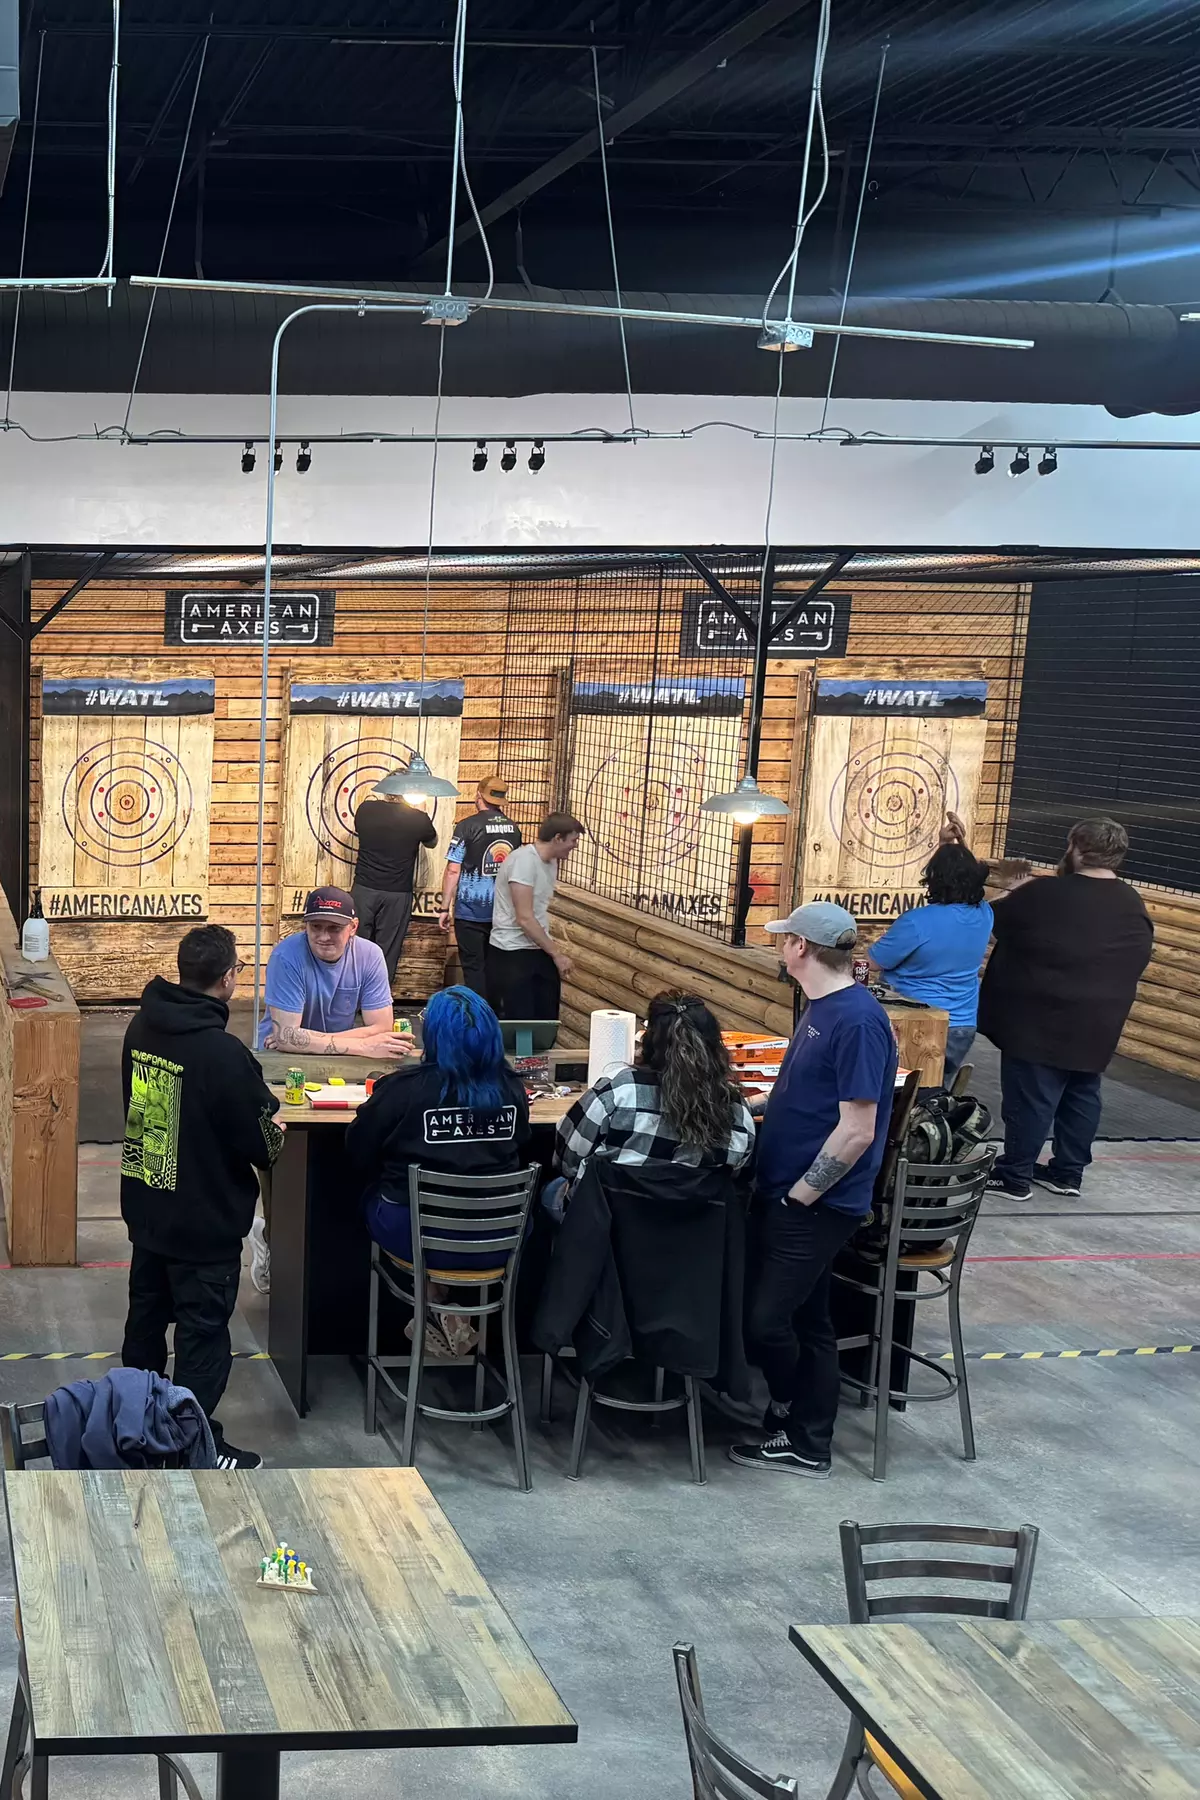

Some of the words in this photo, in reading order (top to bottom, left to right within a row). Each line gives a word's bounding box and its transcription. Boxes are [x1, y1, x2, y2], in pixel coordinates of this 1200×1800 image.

[189, 603, 312, 618] AMERICAN
[220, 620, 280, 635] AXES
[85, 688, 170, 707] #WATL
[336, 690, 421, 709] #WATL
[618, 686, 702, 706] #WATL
[863, 689, 946, 707] #WATL
[485, 824, 515, 834] MARQUEZ
[49, 893, 203, 916] #AMERICANAXES
[429, 1111, 513, 1126] AMERAN
